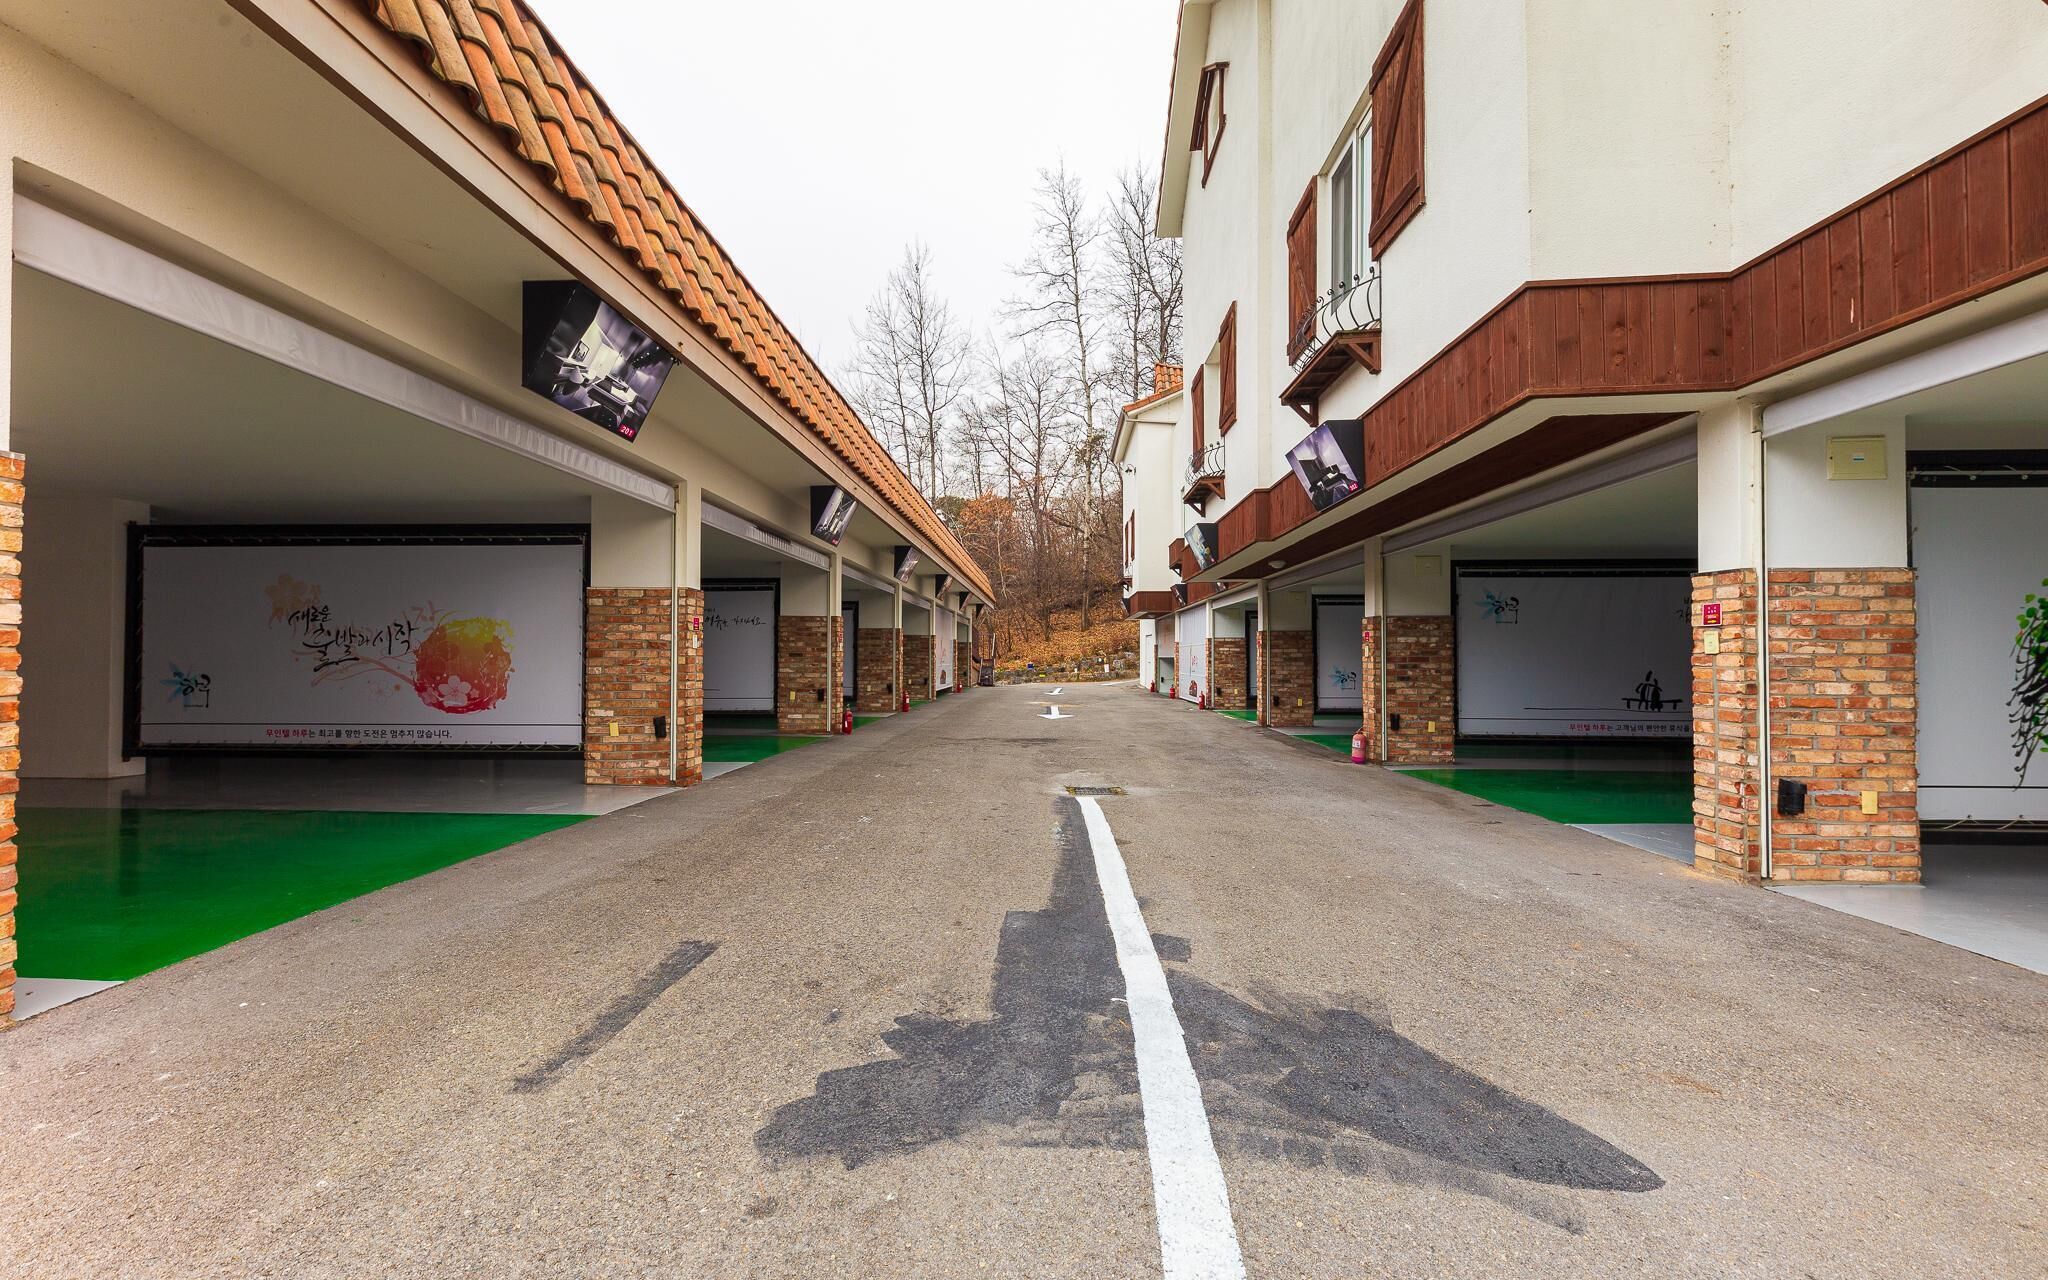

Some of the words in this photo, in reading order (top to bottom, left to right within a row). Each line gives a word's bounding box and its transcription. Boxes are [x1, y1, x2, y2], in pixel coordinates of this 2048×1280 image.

[288, 605, 332, 636] 새로운
[1569, 723, 1590, 732] 무인텔
[265, 729, 291, 739] 무인텔
[292, 729, 317, 739] 하루는
[318, 729, 342, 739] 최고를
[344, 729, 361, 739] 향한
[363, 729, 388, 739] 도전은
[390, 729, 414, 739] 멈추지
[416, 729, 453, 739] 않습니다.
